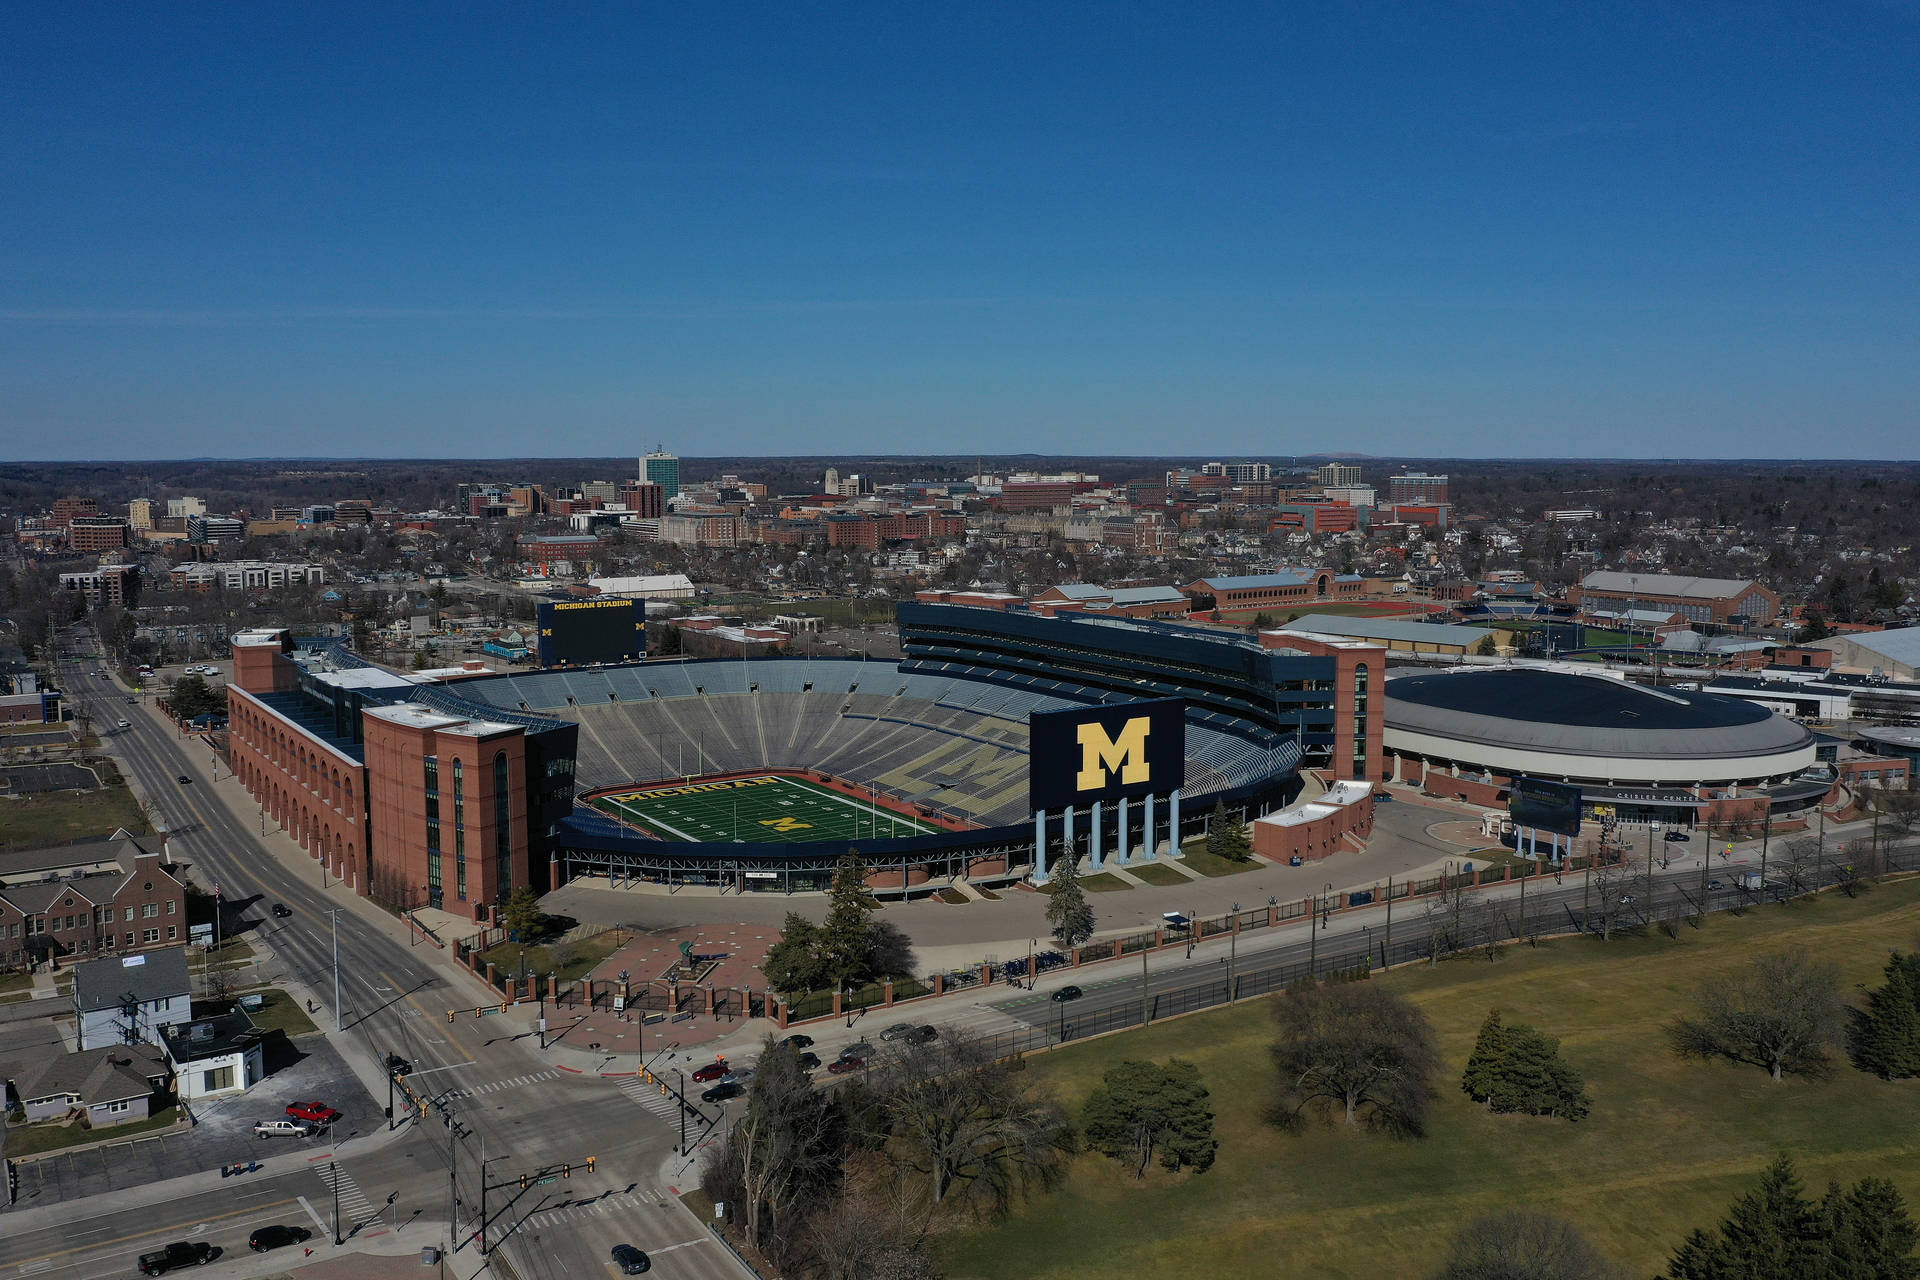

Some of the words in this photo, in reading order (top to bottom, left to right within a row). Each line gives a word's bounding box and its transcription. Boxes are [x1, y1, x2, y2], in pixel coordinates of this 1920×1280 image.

[554, 602, 595, 610] MICHIGAN
[597, 600, 632, 608] STADIUM
[635, 622, 645, 630] M
[542, 628, 552, 636] M
[1077, 716, 1151, 792] M
[613, 777, 779, 803] MICHIGAN
[1616, 793, 1657, 801] CRISLER
[758, 816, 814, 832] M
